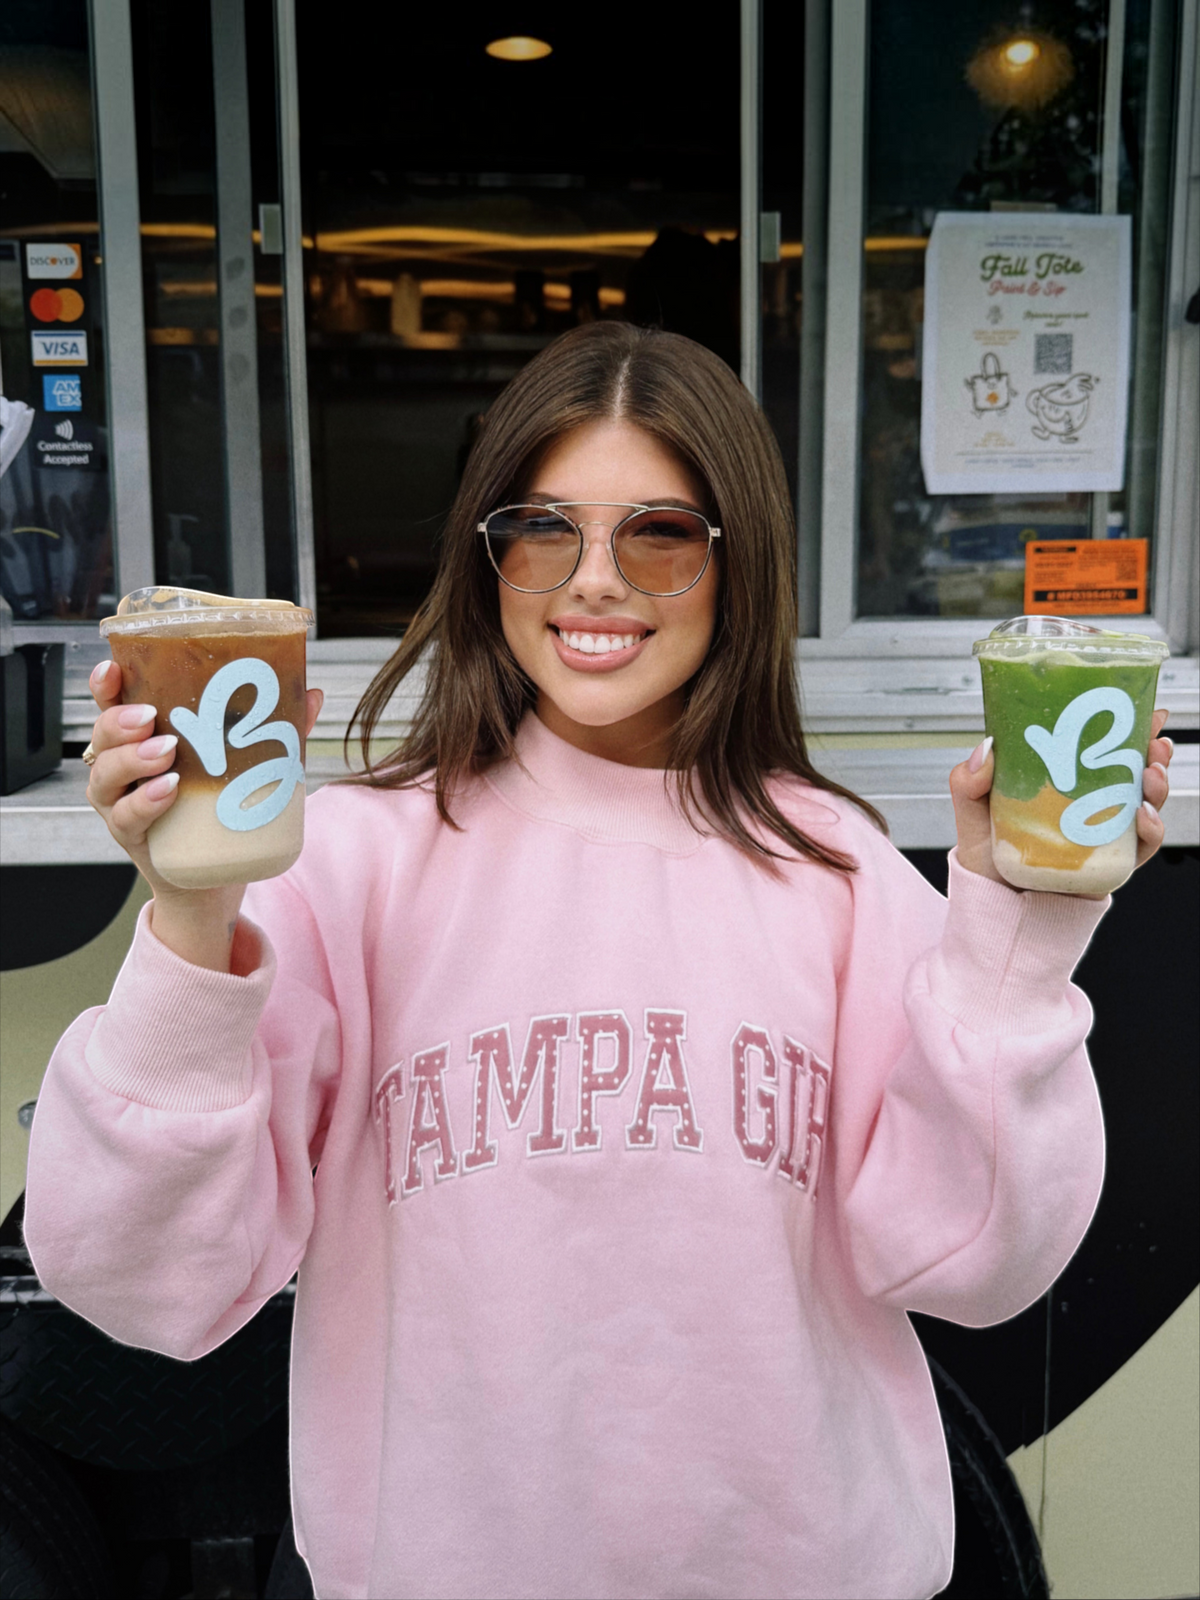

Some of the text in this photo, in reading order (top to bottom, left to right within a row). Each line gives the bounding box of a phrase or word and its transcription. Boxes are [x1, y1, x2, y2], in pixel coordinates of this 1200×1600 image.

[30, 256, 76, 266] DISCOVER
[980, 252, 1084, 282] Fall Tote
[988, 280, 1066, 297] Paint & Sip
[41, 341, 80, 356] VISA
[53, 380, 81, 394] AM
[57, 393, 82, 407] EX
[37, 440, 93, 451] Contactless
[44, 454, 89, 465] Accepted
[375, 1008, 704, 1209] TAMPA
